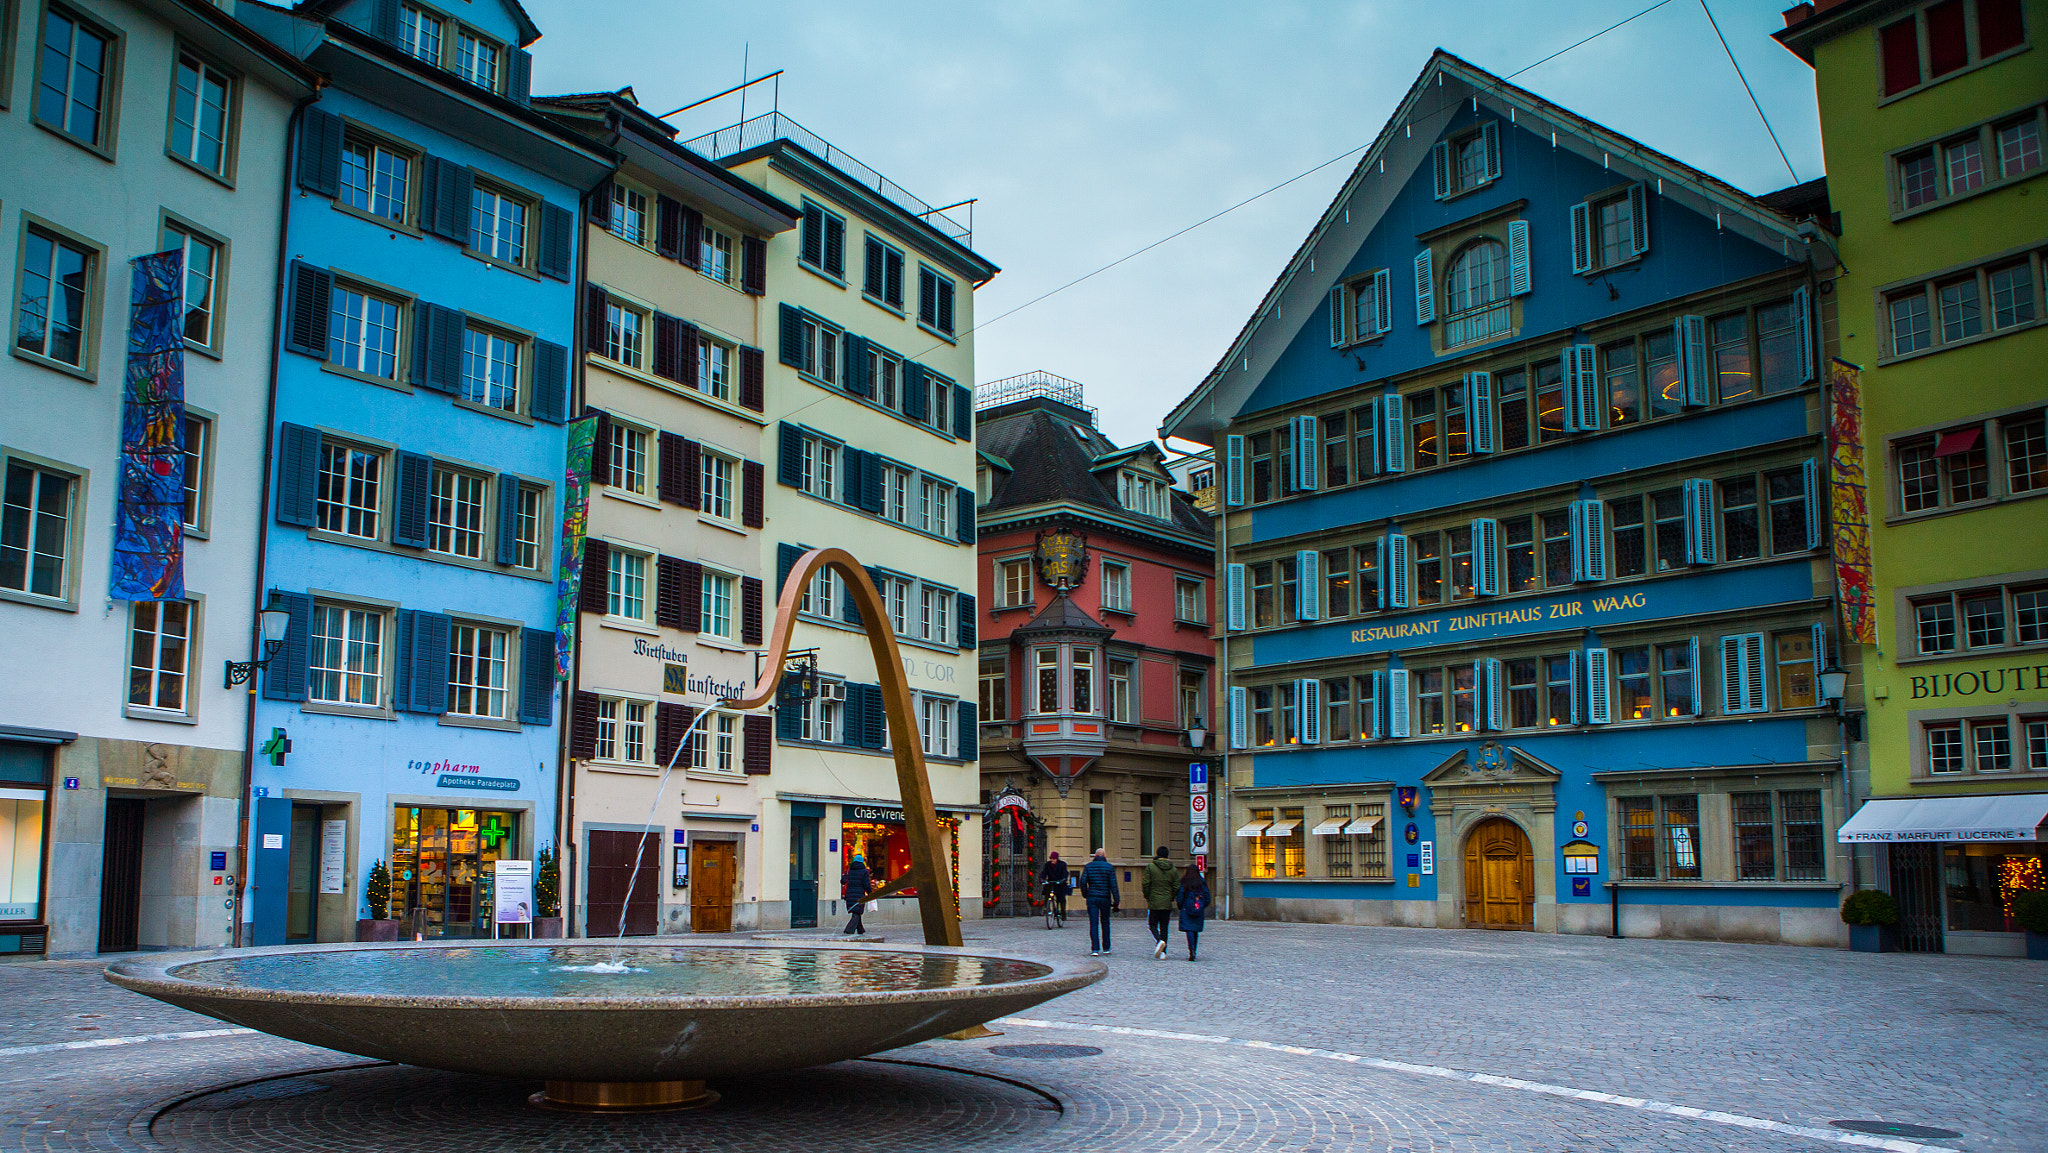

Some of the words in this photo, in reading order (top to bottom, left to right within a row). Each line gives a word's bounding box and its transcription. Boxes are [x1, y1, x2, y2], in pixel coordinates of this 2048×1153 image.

[1351, 619, 1440, 643] RESTAURANT
[1449, 606, 1542, 631] ZUNFTHAUS
[1549, 601, 1583, 619] ZUR
[1592, 592, 1646, 612] WAAG
[924, 660, 955, 683] TOR
[1910, 665, 2048, 699] BIJOUTE
[408, 759, 480, 775] toppharm
[442, 777, 476, 786] Apotheke
[477, 779, 517, 789] Paradeplatz
[854, 806, 905, 820] Chäs-Vrene
[1855, 832, 1893, 841] FRANZ
[1897, 831, 1952, 840] MARFURT
[1957, 830, 2015, 839] LUCERNE
